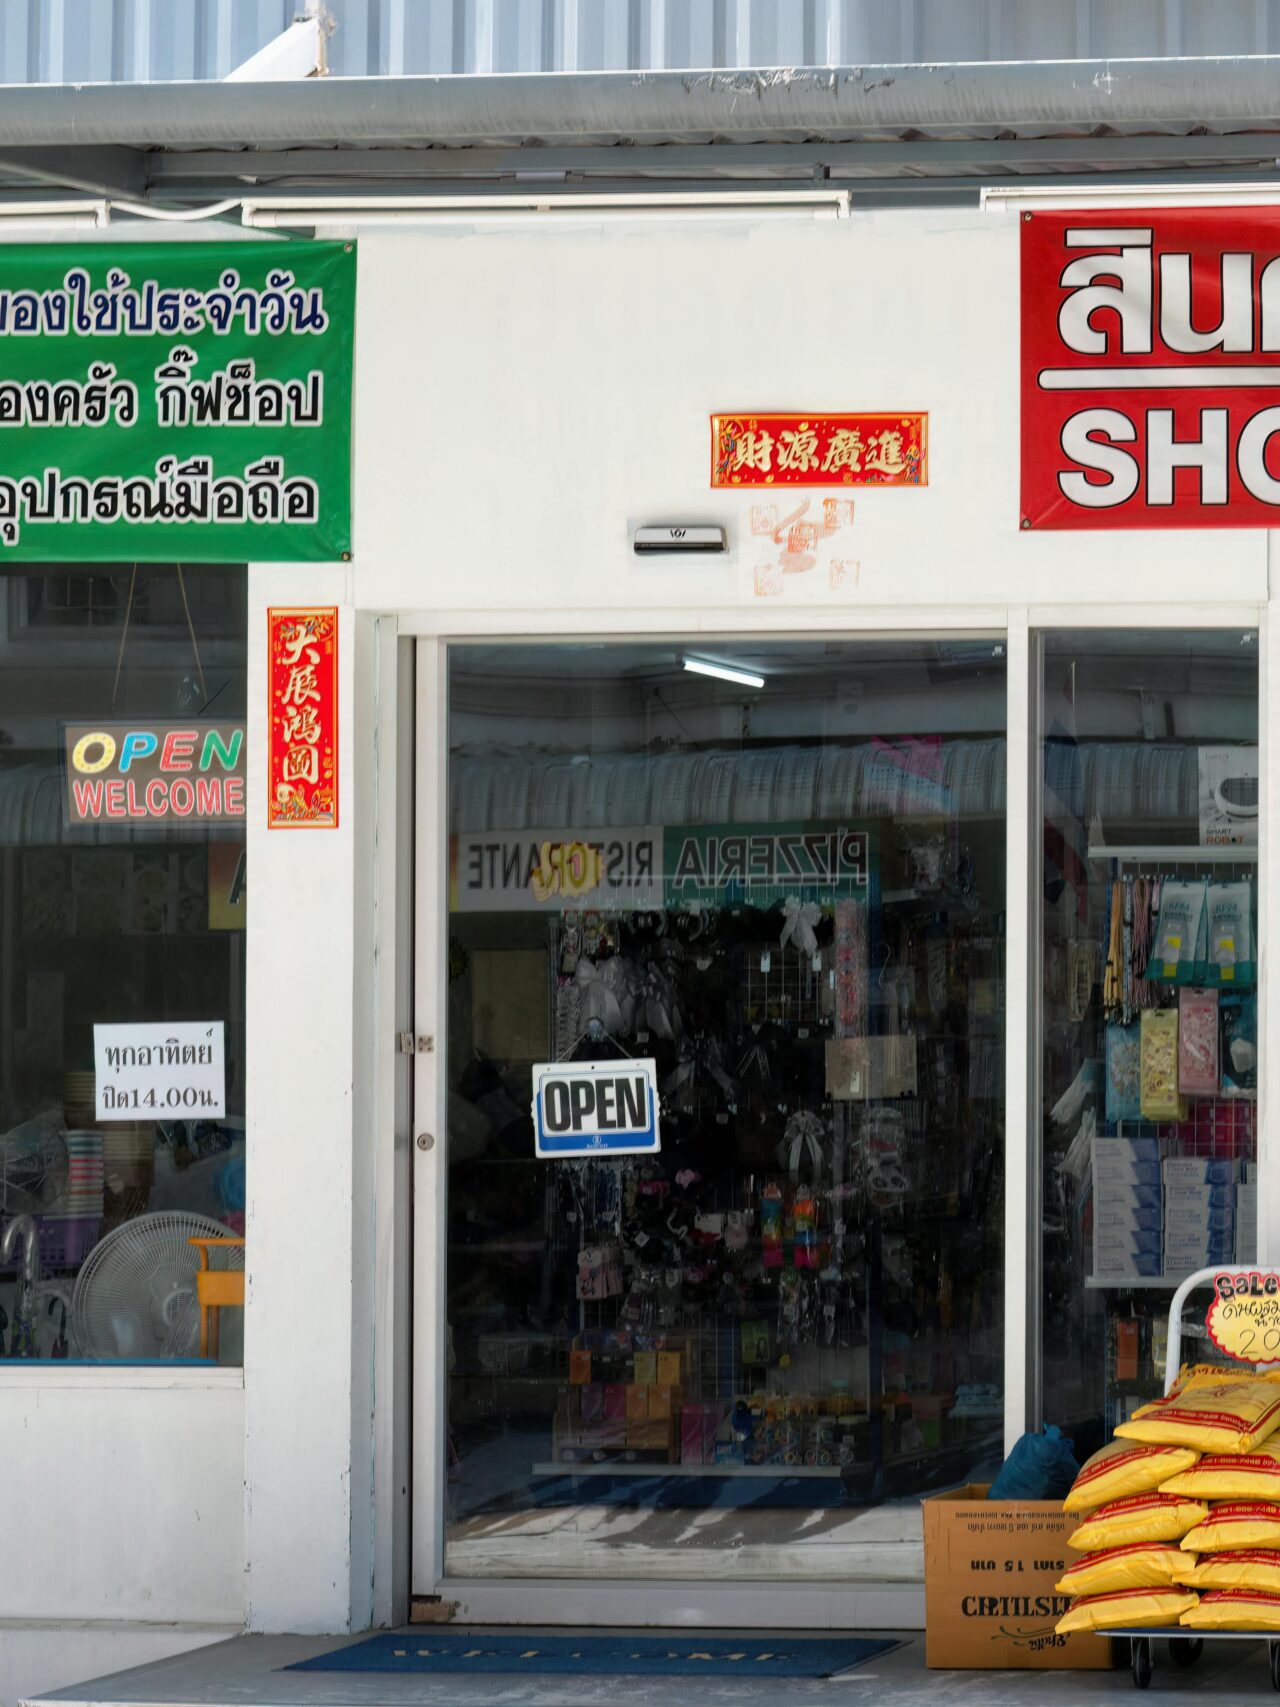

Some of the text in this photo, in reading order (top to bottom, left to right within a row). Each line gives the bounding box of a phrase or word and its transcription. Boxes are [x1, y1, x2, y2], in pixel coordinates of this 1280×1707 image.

[0, 270, 326, 334] องใช้ประจำวัน
[156, 347, 324, 426] กิ๊ฟช็อป
[72, 728, 243, 774] OPEN
[73, 777, 244, 818] WELCOME
[105, 1028, 214, 1074] ทุกอาทิตย์
[544, 1077, 647, 1132] OPEN
